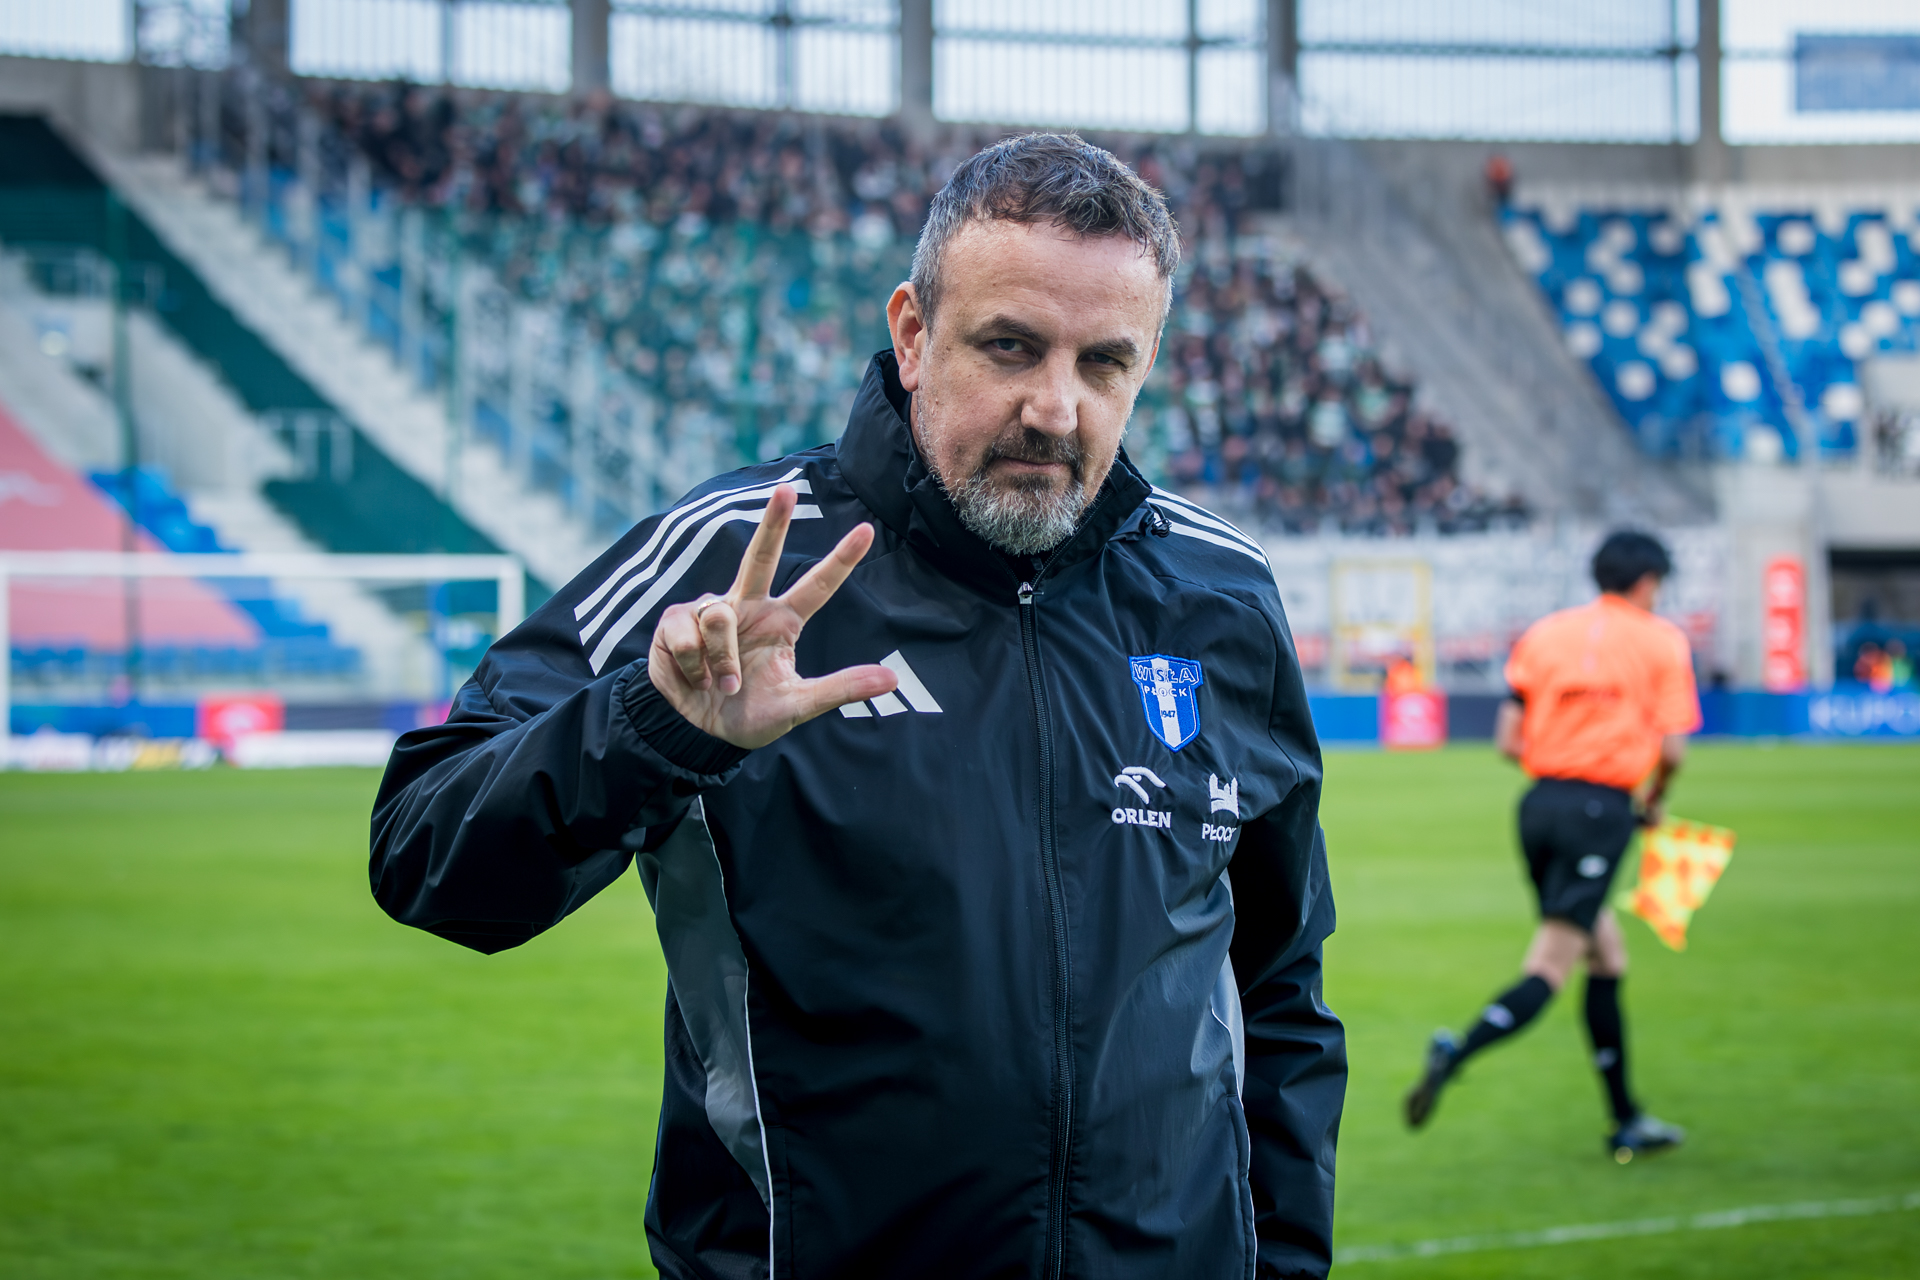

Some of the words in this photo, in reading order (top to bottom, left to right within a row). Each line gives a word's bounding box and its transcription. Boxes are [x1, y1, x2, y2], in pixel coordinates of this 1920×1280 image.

[1133, 663, 1196, 684] WISŁA
[1143, 685, 1188, 698] PŁOCK
[1160, 709, 1176, 718] 1947
[1111, 807, 1172, 829] ORLEN
